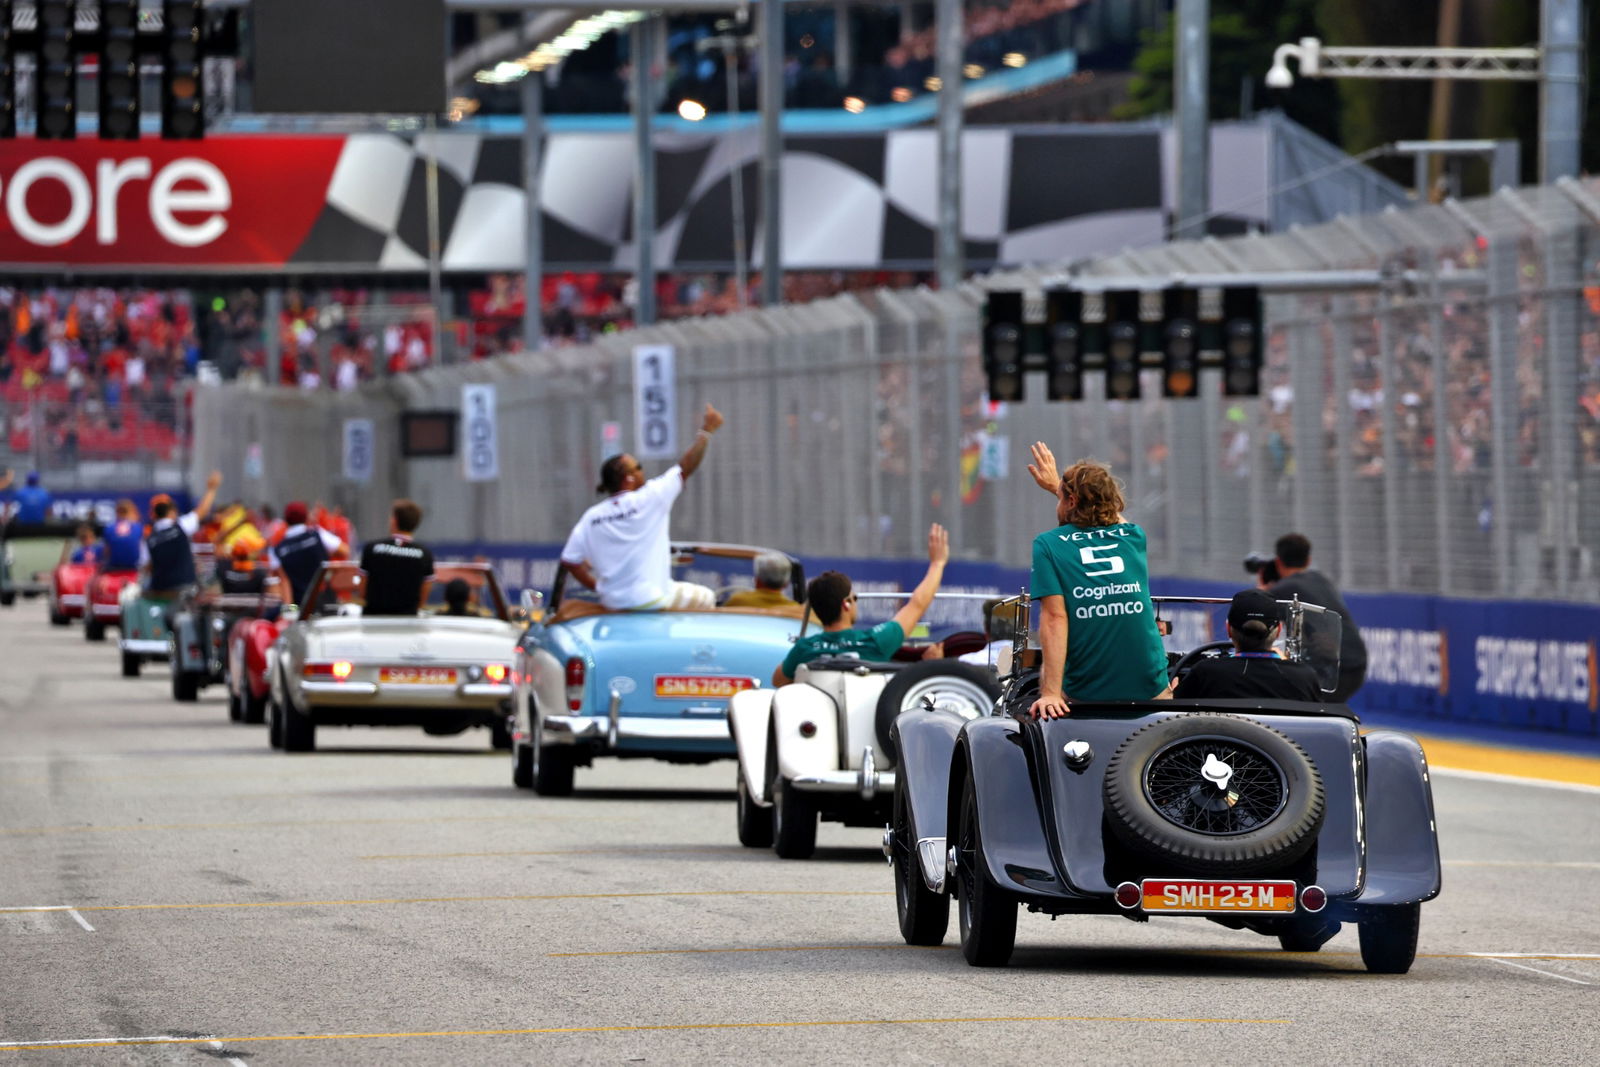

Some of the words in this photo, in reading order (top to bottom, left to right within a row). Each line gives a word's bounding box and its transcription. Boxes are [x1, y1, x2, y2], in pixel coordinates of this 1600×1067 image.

[0, 156, 232, 247] ore
[644, 355, 668, 450] 150
[1079, 543, 1125, 577] 5
[1072, 581, 1142, 600] Cognizant
[1076, 601, 1144, 619] aramco
